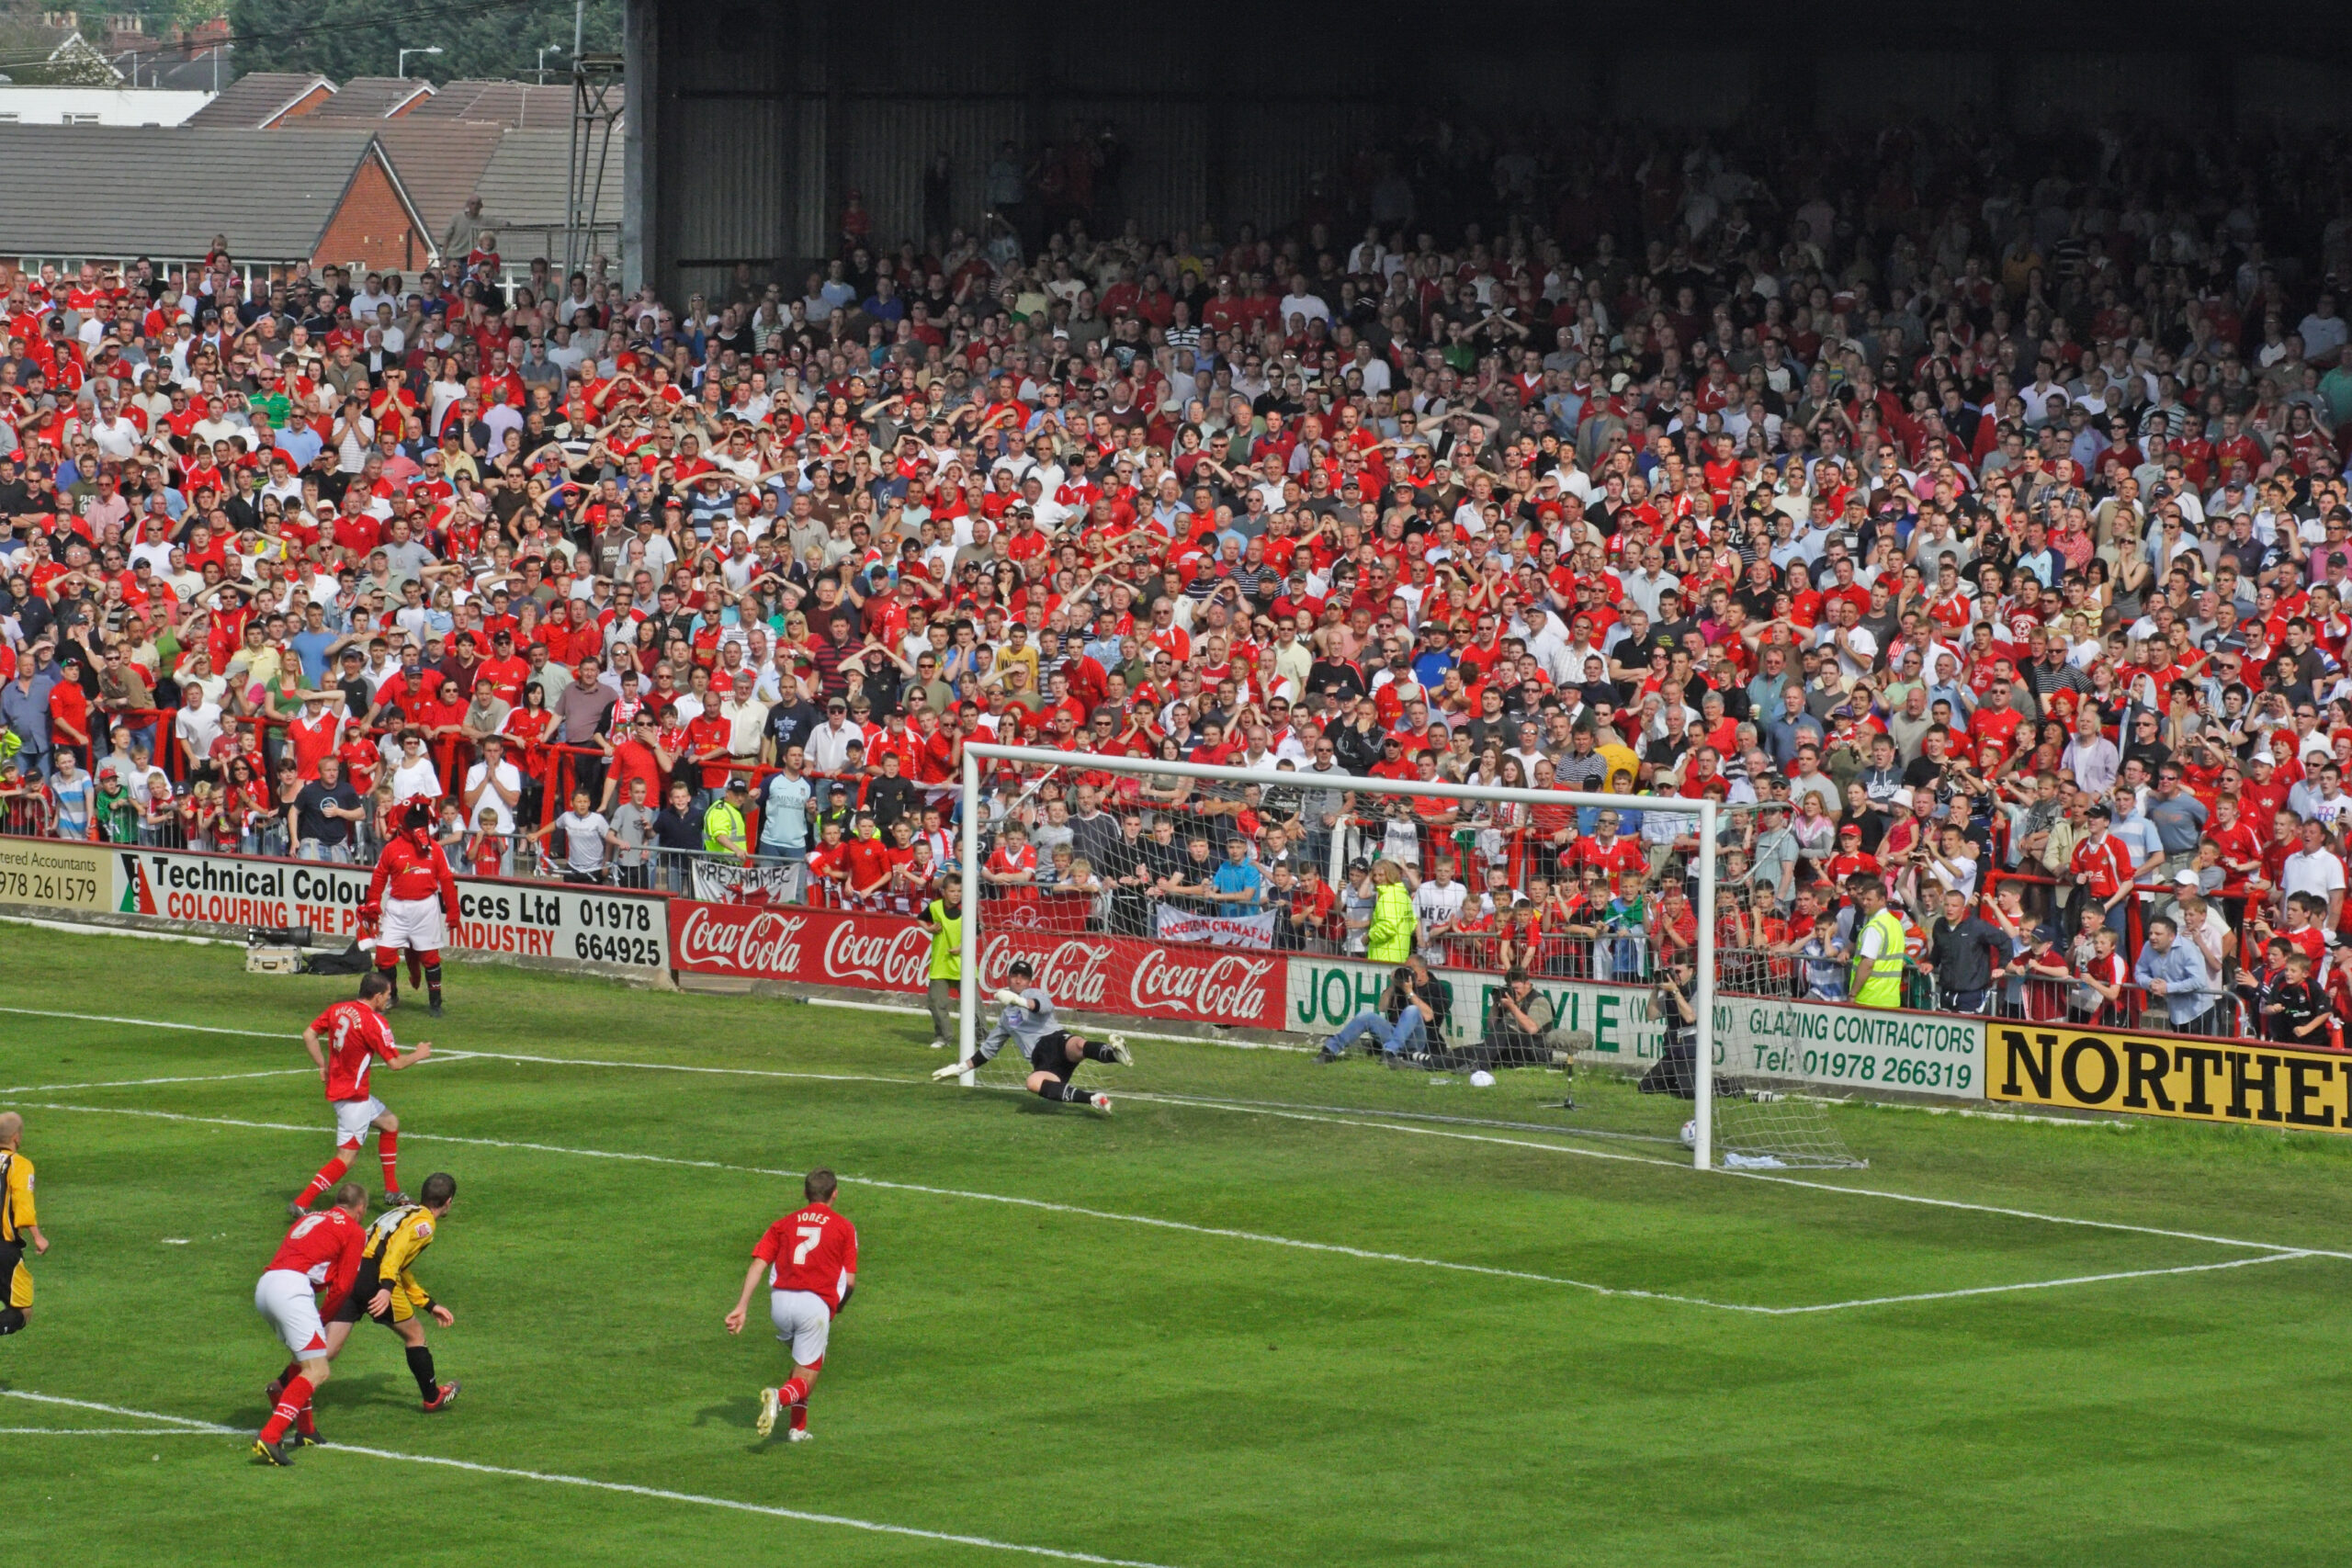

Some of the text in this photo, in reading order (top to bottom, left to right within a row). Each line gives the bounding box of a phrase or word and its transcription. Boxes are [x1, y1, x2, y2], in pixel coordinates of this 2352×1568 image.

[31, 852, 96, 872] Accountants
[34, 874, 96, 902] 261579
[153, 856, 284, 897] Technical
[293, 869, 370, 905] Colou
[520, 893, 560, 927] Ltd
[167, 891, 288, 929] COLOURING
[296, 904, 334, 933] THE
[580, 898, 650, 931] 01978
[449, 920, 554, 956] INDUSTRY
[575, 932, 661, 965] 664925
[680, 907, 808, 974] Coca-Cola
[824, 919, 933, 987] Coca-Col
[1130, 949, 1275, 1020] Coca-Cola
[1297, 967, 1393, 1027] JOH
[333, 1015, 350, 1053] 3
[1749, 1008, 1827, 1041] GLAZING
[1835, 1016, 1974, 1054] CONTRACTORS
[1753, 1043, 1972, 1090] Tel: 01978 266319
[2001, 1030, 2352, 1129] NORTHE
[797, 1213, 830, 1224] JONES
[793, 1226, 822, 1265] 7
